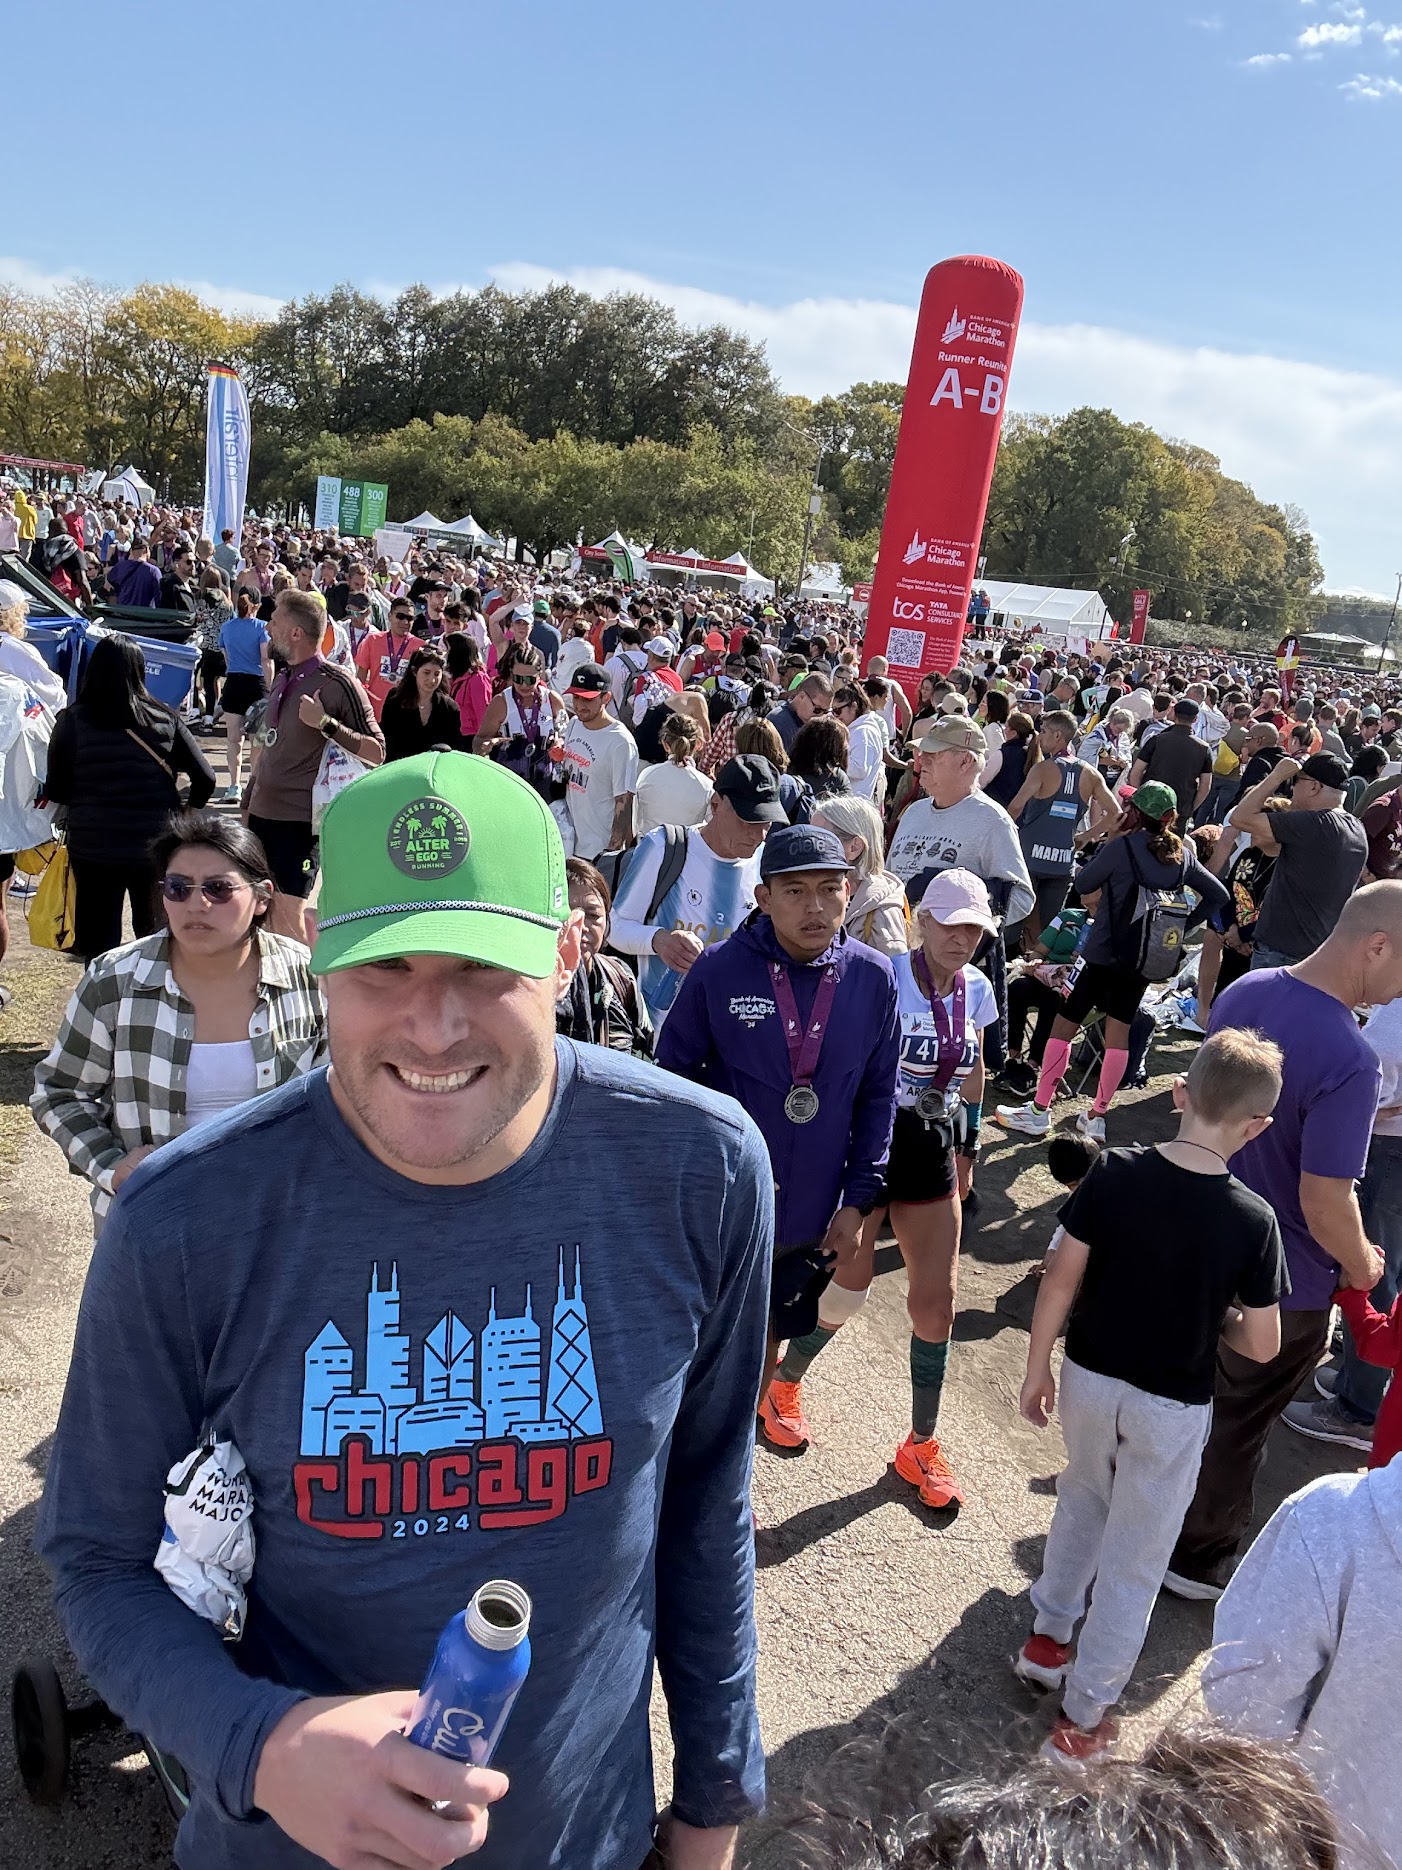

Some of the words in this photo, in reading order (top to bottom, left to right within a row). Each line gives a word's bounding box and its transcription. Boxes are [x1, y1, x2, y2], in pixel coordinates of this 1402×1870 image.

[968, 322, 1002, 337] Chicago
[966, 332, 1006, 348] Marathon
[938, 351, 975, 365] Runner
[978, 356, 1008, 373] Reunite
[929, 367, 1004, 416] A-B
[320, 482, 338, 495] 310
[343, 486, 361, 498] 488
[366, 488, 384, 501] 300
[928, 544, 962, 559] Chicago
[652, 554, 690, 567] Information
[702, 561, 741, 574] Information
[926, 554, 966, 568] Marathon
[896, 582, 914, 590] Chicago
[915, 585, 938, 593] Marathon
[901, 576, 926, 586] Download
[934, 581, 946, 589] Bank
[892, 595, 925, 621] tcs
[929, 601, 948, 610] TATA
[926, 616, 953, 626] SERVICES
[393, 802, 426, 834] ENDLESS
[429, 802, 463, 831] SUMMER
[405, 838, 450, 853] ALTER
[415, 851, 438, 862] EGO
[1031, 843, 1072, 863] MARTIN
[411, 862, 446, 870] RUNNING
[730, 996, 744, 1005] Bank
[751, 995, 775, 1006] America
[196, 1484, 246, 1505] MARA
[188, 1498, 243, 1522] MAJO
[392, 1513, 470, 1538] 2024
